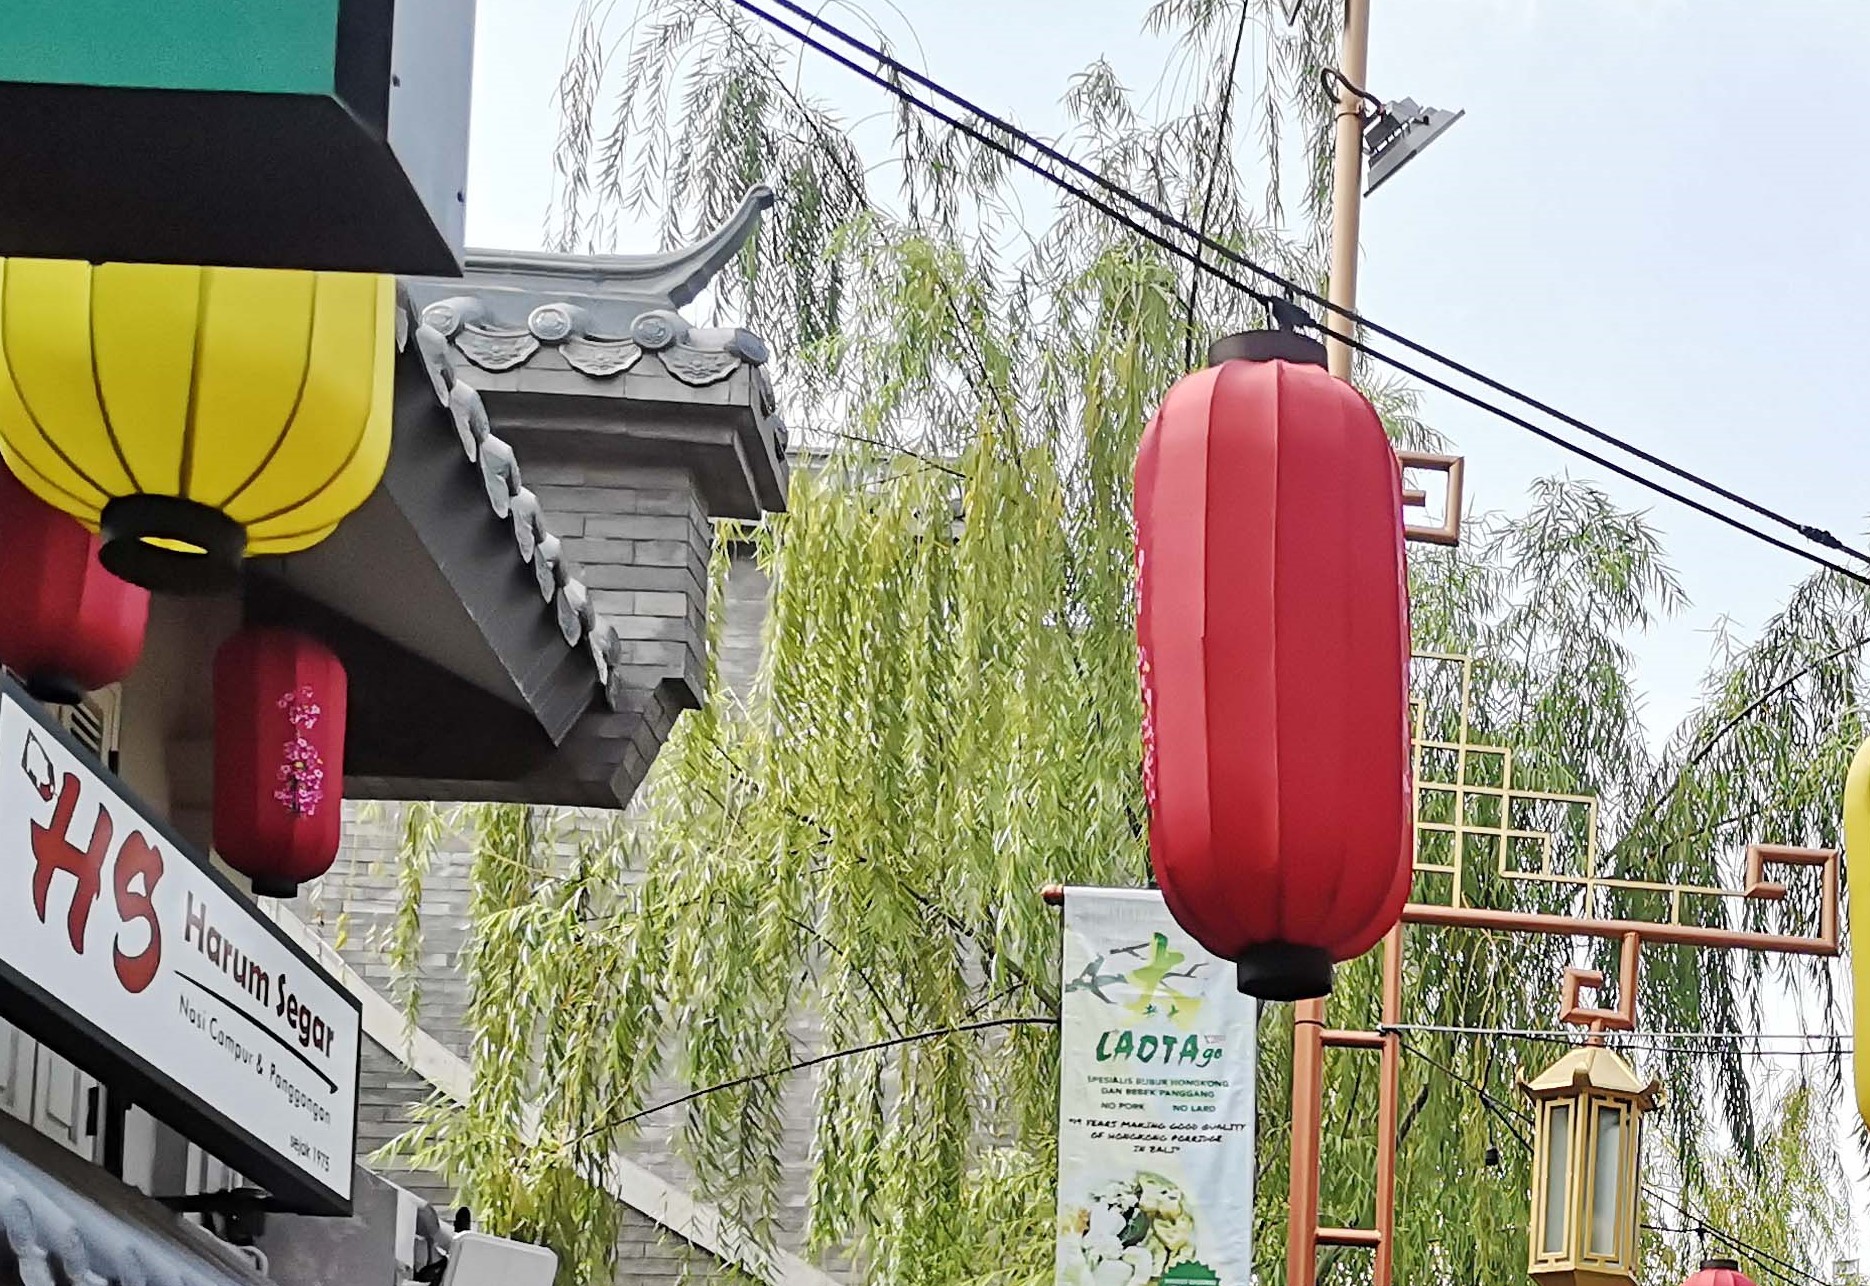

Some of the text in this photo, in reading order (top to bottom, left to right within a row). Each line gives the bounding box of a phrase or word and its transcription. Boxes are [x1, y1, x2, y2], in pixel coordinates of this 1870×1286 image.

[30, 772, 163, 994] HS
[183, 890, 335, 1058] Harum Segar
[178, 994, 331, 1126] Nasi Campur & Panggangan
[1096, 1030, 1199, 1065] LAOTA
[1101, 1087, 1122, 1095] DAN
[1159, 1089, 1215, 1098] PANGGANG
[1101, 1102, 1116, 1110] NO
[1119, 1102, 1144, 1110] PORK
[1191, 1105, 1216, 1113] LARD
